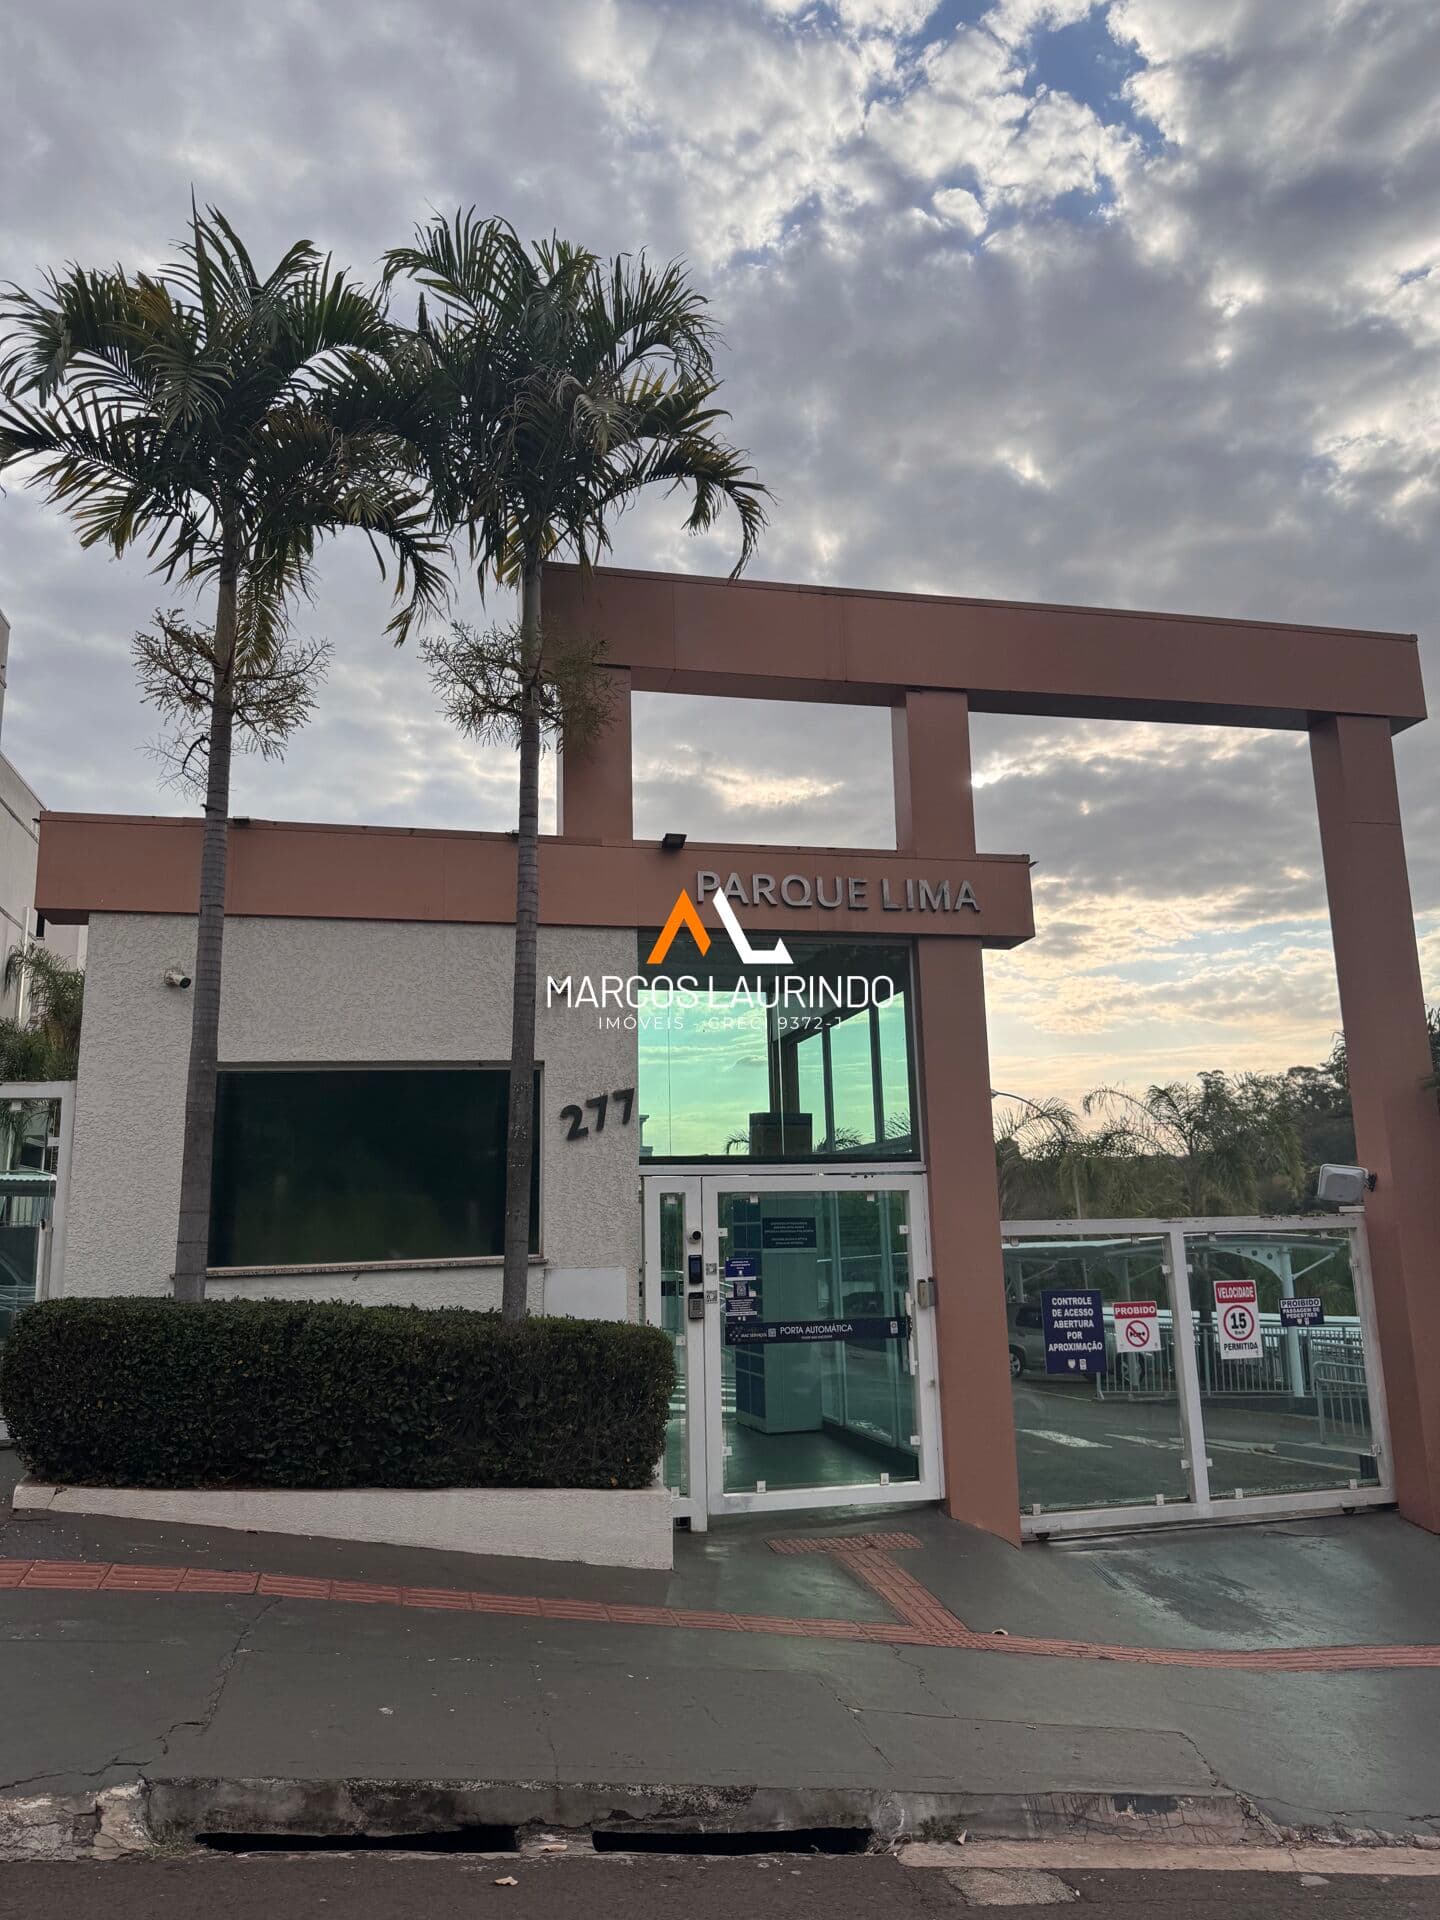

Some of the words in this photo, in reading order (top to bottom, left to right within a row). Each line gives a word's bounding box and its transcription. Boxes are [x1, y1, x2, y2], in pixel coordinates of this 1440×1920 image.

[697, 870, 869, 910] PARQUE
[881, 878, 982, 913] LIMA
[560, 1087, 636, 1142] 277
[1217, 1286, 1254, 1298] VELOCIDADE
[1051, 1296, 1093, 1306] CONTROLE
[1281, 1299, 1320, 1308] PROIBIDO
[1051, 1308, 1063, 1317] DE
[1064, 1308, 1094, 1317] ACESSO
[1114, 1306, 1156, 1315] PROBIDO
[1053, 1320, 1095, 1329] ABERTURA
[1230, 1312, 1247, 1330] 15
[779, 1325, 804, 1335] PORTA
[804, 1323, 854, 1334] AUTOMÁTICA
[1066, 1331, 1083, 1340] POR
[1048, 1341, 1103, 1353] APROXIMAÇÃO
[1223, 1342, 1259, 1351] PERMITIDA
